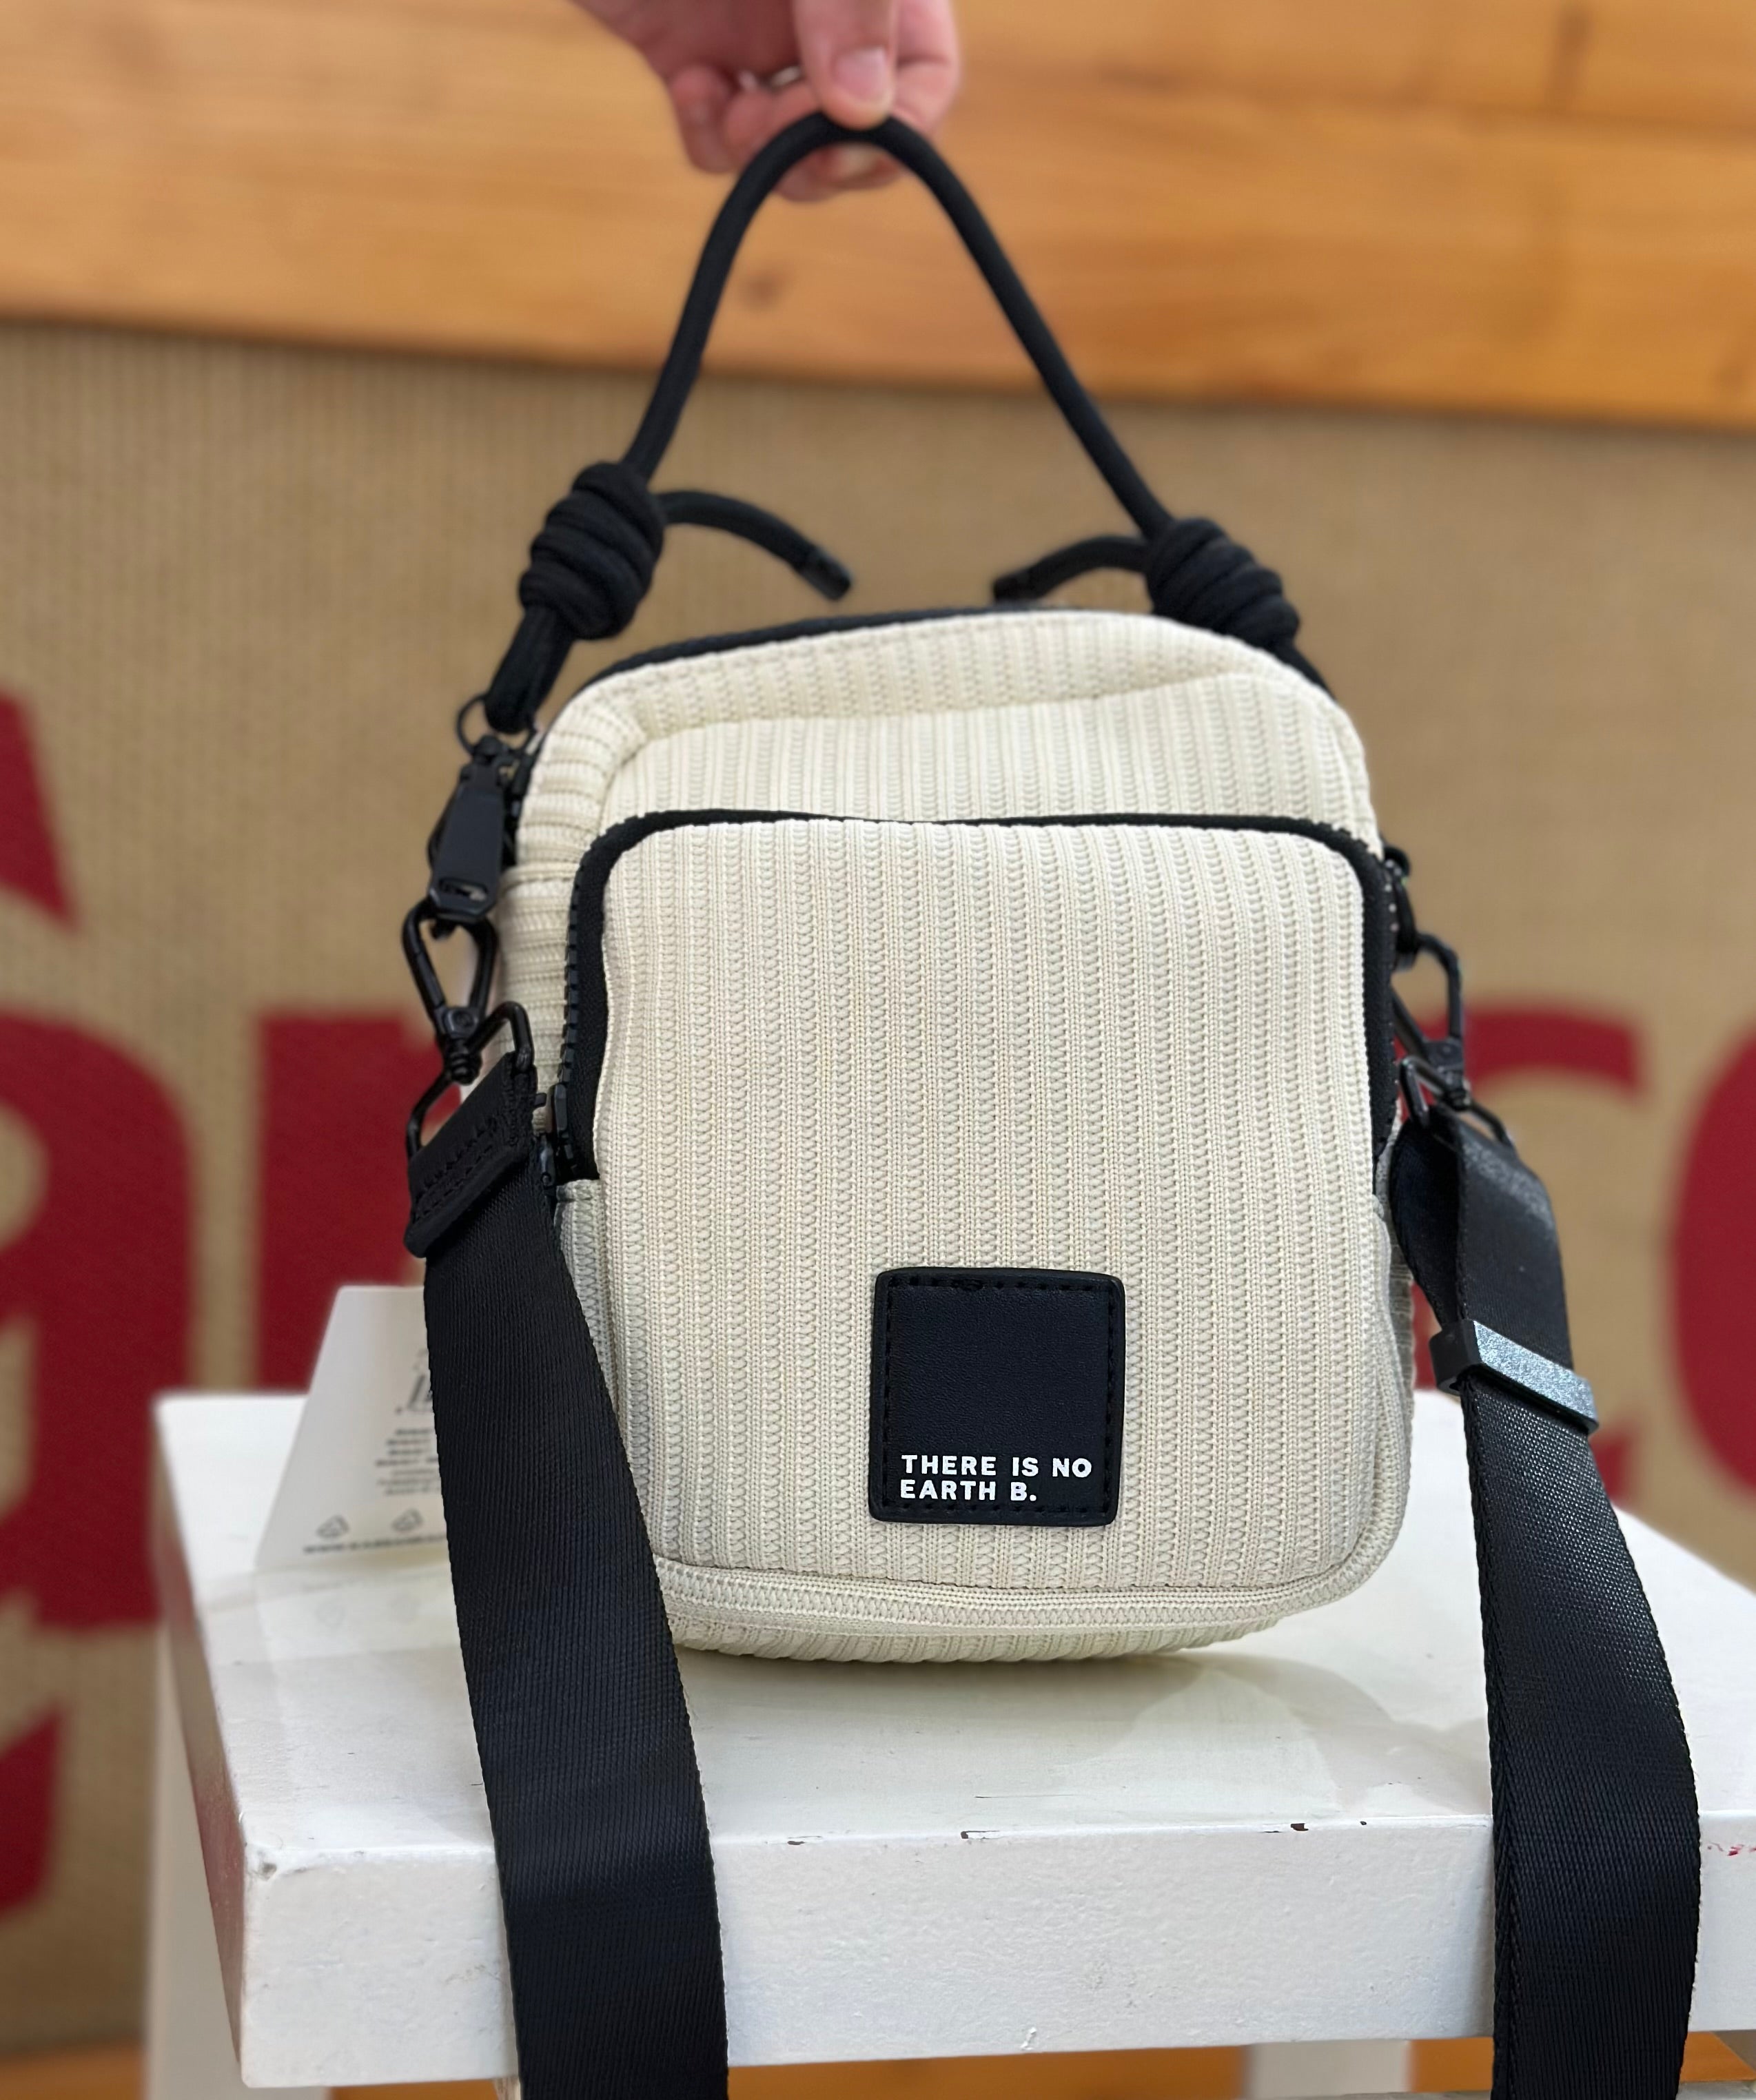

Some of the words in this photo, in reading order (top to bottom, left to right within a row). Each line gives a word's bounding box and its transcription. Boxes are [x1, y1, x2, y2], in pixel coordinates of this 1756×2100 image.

[901, 1454, 997, 1476] THERE
[1012, 1456, 1039, 1477] IS
[1052, 1457, 1092, 1478] NO
[900, 1479, 997, 1501] EARTH
[1010, 1481, 1037, 1501] B.
